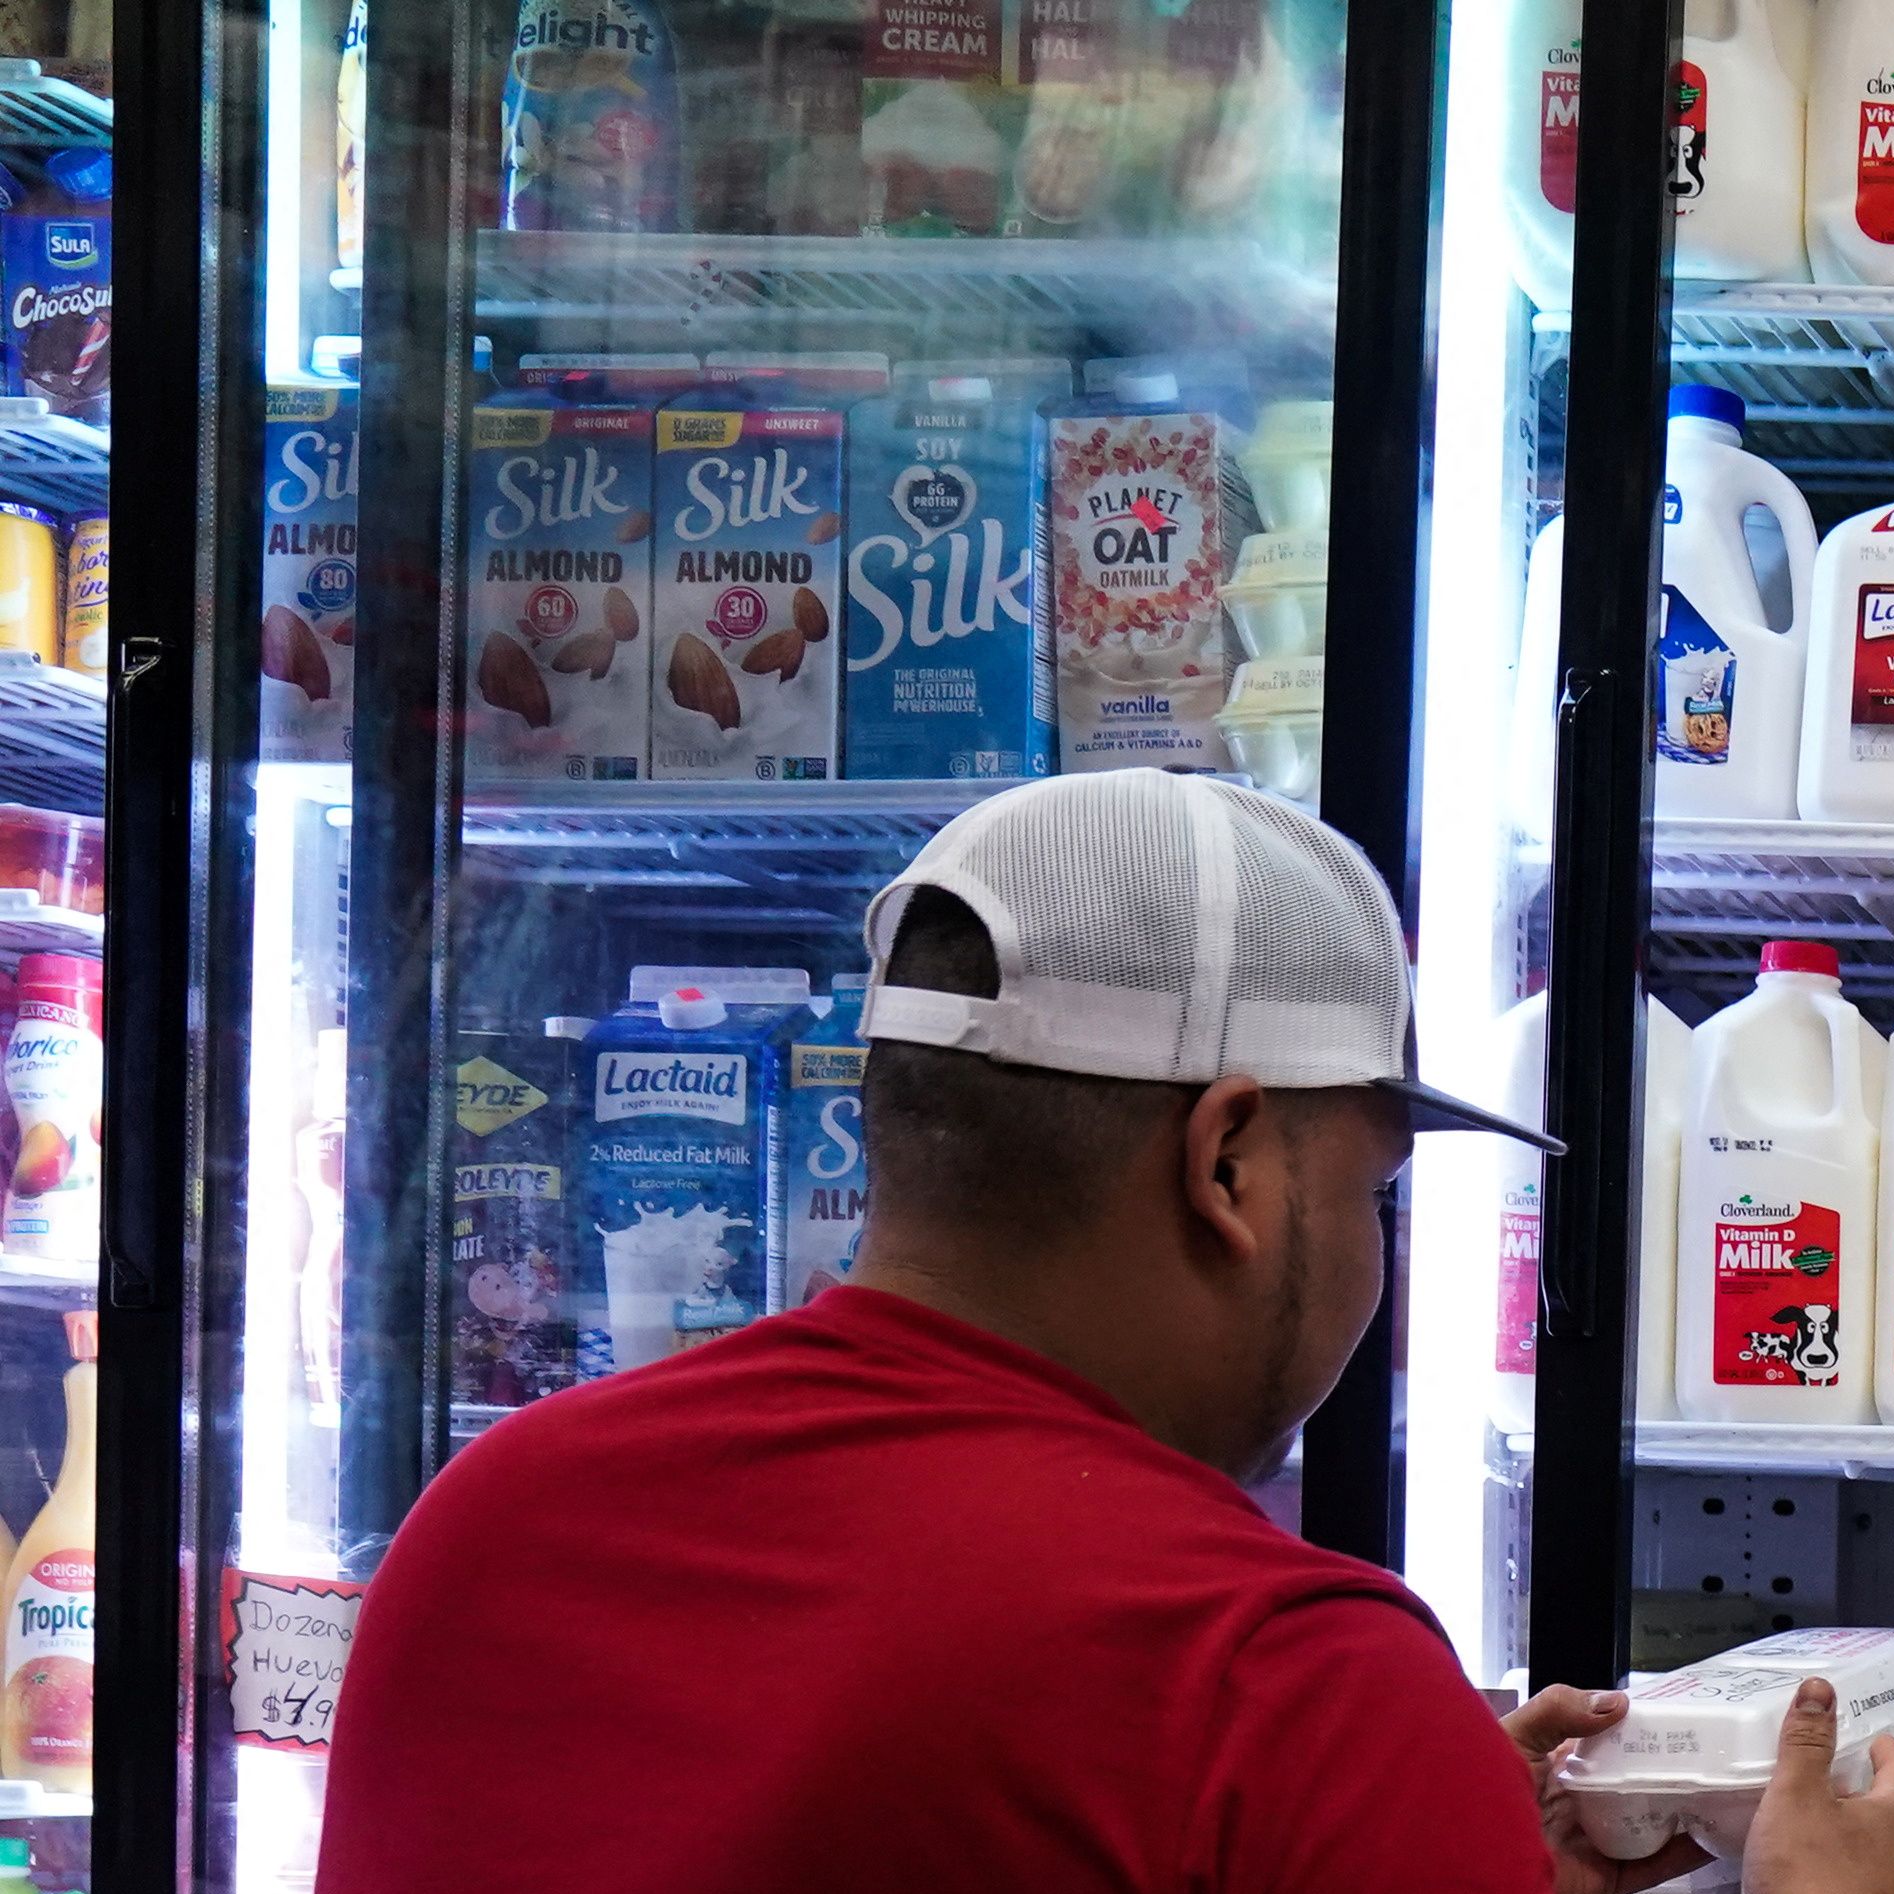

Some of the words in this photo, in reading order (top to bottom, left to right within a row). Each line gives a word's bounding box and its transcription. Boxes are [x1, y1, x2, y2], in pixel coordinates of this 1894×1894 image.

[885, 8, 986, 30] WHIPPING
[882, 29, 988, 56] CREAM
[51, 236, 90, 253] SULA
[765, 418, 819, 431] UNSWEET
[915, 415, 966, 429] VANILLA
[915, 438, 964, 461] SOY
[485, 447, 630, 540] Silk
[675, 448, 820, 542] Silk
[913, 495, 959, 509] PROTEIN
[1088, 487, 1183, 518] PLANET
[1093, 528, 1177, 565] OAT
[486, 551, 623, 583] ALMOND
[676, 552, 813, 584] ALMOND
[1100, 568, 1170, 588] OATMILK
[849, 519, 1031, 672] Silk
[728, 598, 754, 618] 30
[918, 669, 974, 682] ORIGINAL
[894, 681, 976, 699] NUTRITION
[1101, 695, 1170, 715] vanilla
[604, 1058, 738, 1097] Lactaid
[612, 1145, 683, 1163] Reduced
[686, 1146, 711, 1165] Fat
[715, 1146, 751, 1165] Milk
[1720, 1204, 1791, 1220] Cloverland
[1719, 1228, 1780, 1241] Vitamin
[1783, 1230, 1796, 1242] D
[1719, 1242, 1794, 1270] Milk
